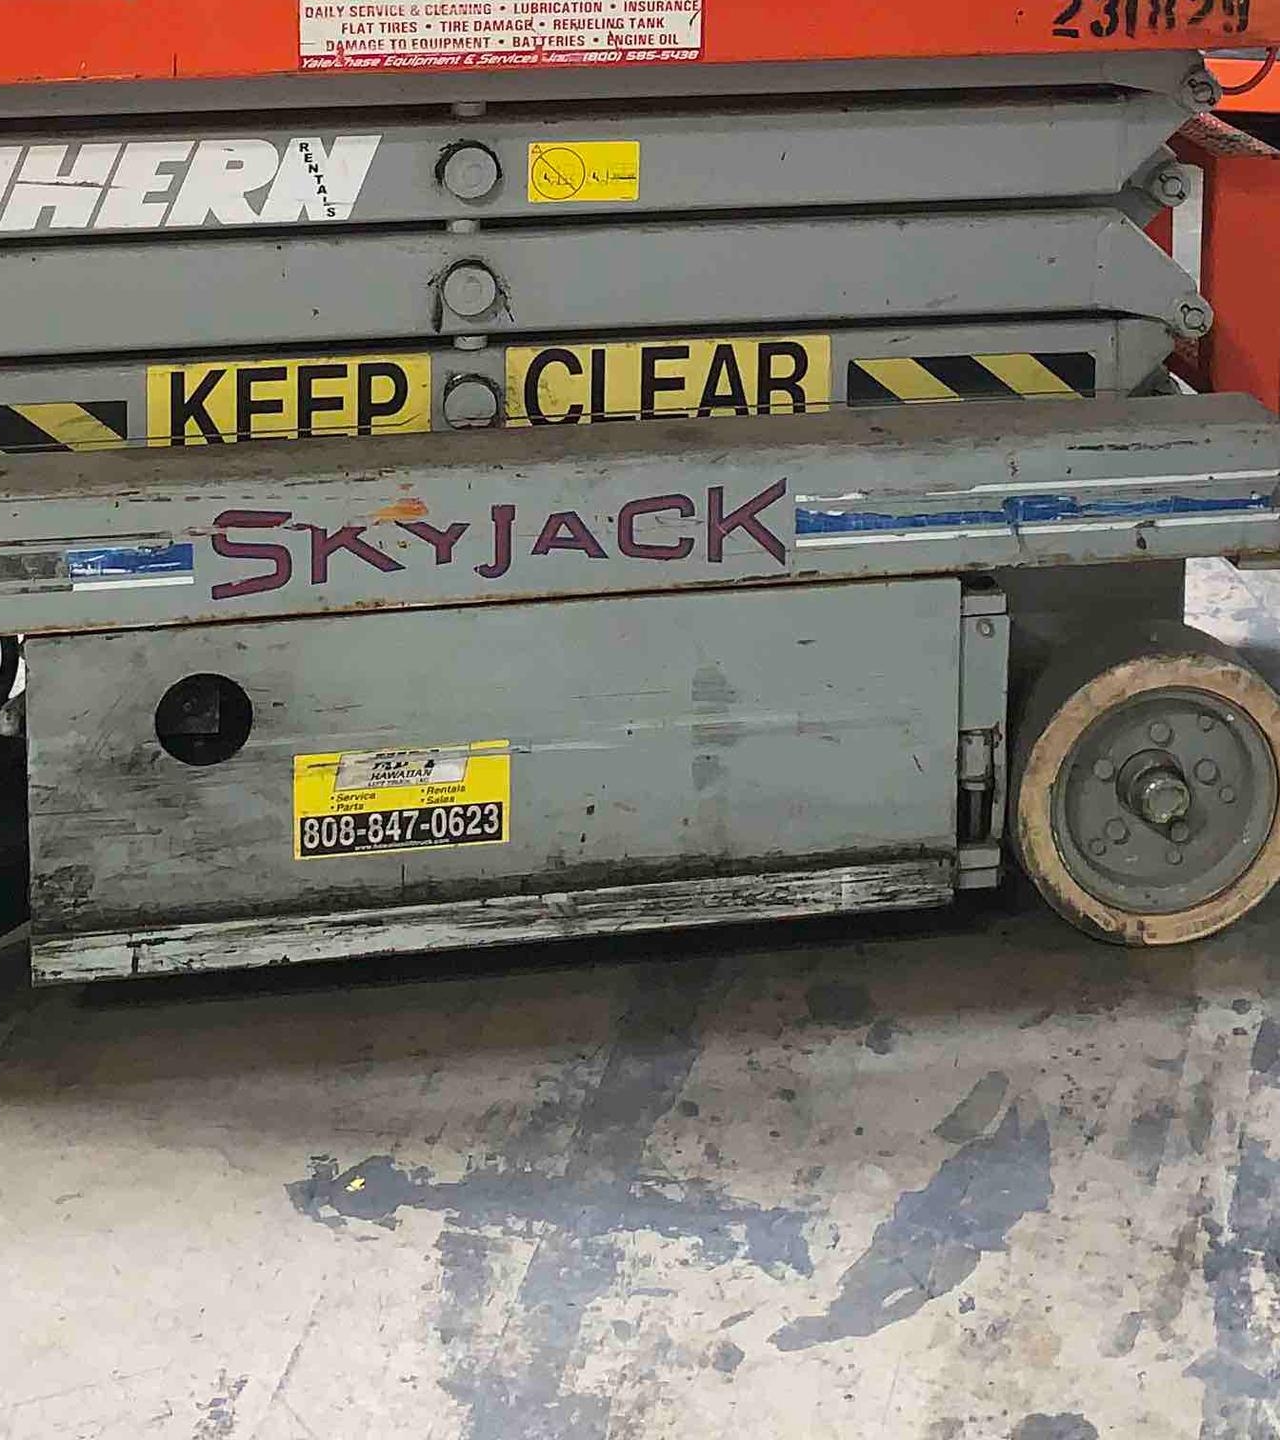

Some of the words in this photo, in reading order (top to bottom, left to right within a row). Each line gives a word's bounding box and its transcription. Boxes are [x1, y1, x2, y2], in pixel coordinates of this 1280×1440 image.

[305, 5, 344, 18] DAILY
[349, 5, 405, 17] SERVICE
[410, 5, 420, 16] &
[425, 3, 492, 16] CLEANING
[513, 1, 602, 15] LUBRICATION
[624, 0, 699, 12] INSURANCE
[341, 22, 373, 35] FLAT
[379, 21, 418, 34] TIRES
[440, 21, 469, 33] TIRE
[474, 18, 533, 32] DAMAGE
[553, 17, 625, 31] REFUELING
[629, 16, 665, 29] TANK
[326, 39, 385, 52] DAMAGE
[390, 39, 407, 50] TO
[412, 37, 492, 50] EQUIPMENT
[512, 35, 585, 48] BATTERIES
[607, 33, 655, 46] ENGINE
[659, 33, 679, 45] OIL
[384, 53, 464, 67] Equipment
[478, 52, 538, 64] Services
[299, 142, 336, 217] RENTALS
[523, 341, 811, 427] CLEAR
[170, 361, 409, 445] KEEP
[210, 477, 788, 601] SKYJACK
[370, 769, 432, 781] HAWAIIAN
[336, 792, 376, 803] Service
[426, 785, 466, 795] Rentals
[336, 803, 364, 812] Parts
[426, 795, 455, 804] Sales
[303, 803, 500, 849] 808-847-0623
